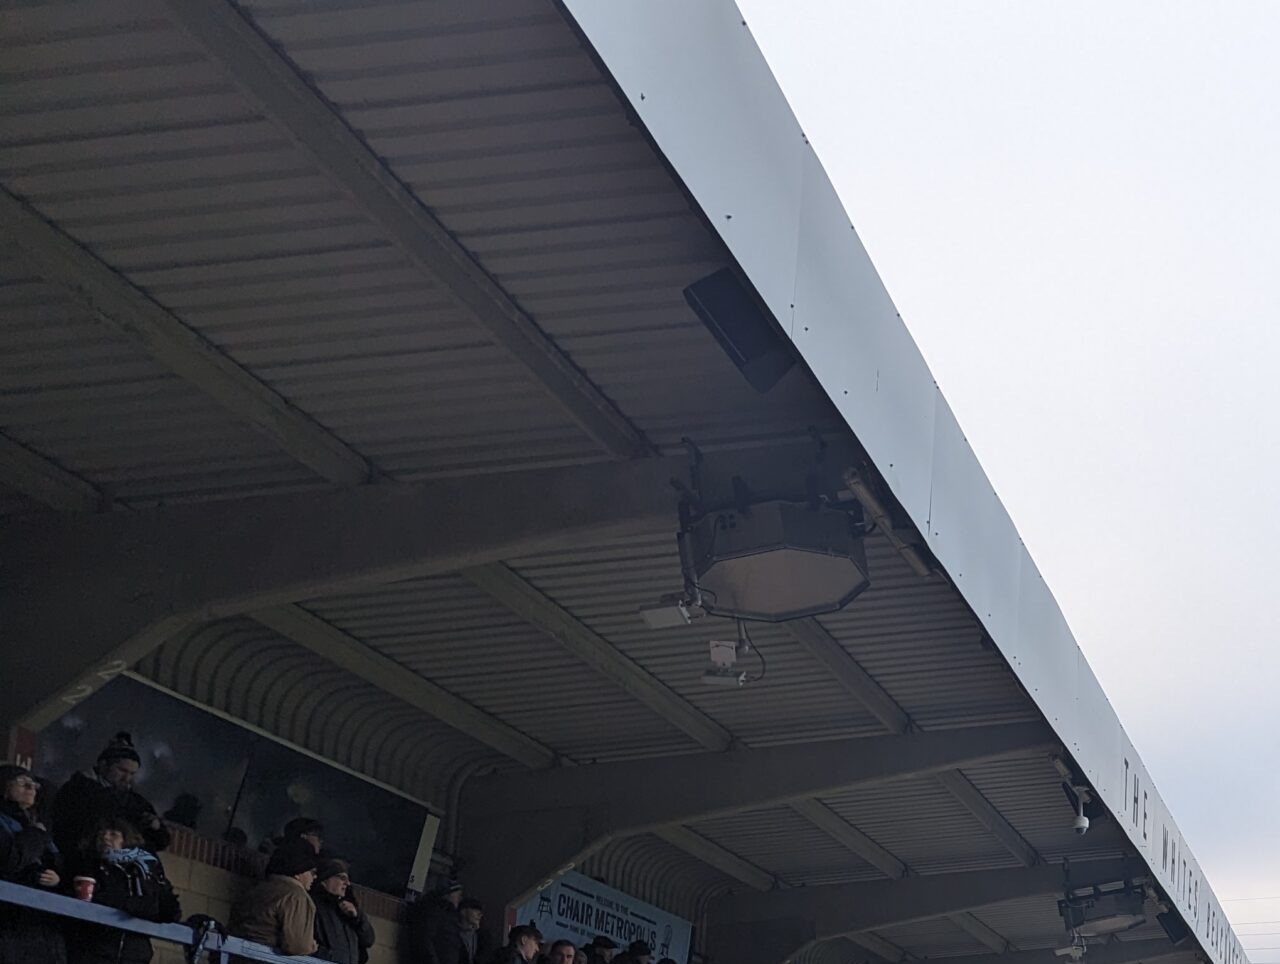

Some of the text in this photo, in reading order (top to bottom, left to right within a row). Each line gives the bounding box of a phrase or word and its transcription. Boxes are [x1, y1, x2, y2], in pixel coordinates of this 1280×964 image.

[1123, 757, 1148, 841] THE
[1161, 823, 1200, 919] WHITES
[557, 893, 593, 927] CHAIR
[594, 907, 657, 951] METROPOLIS
